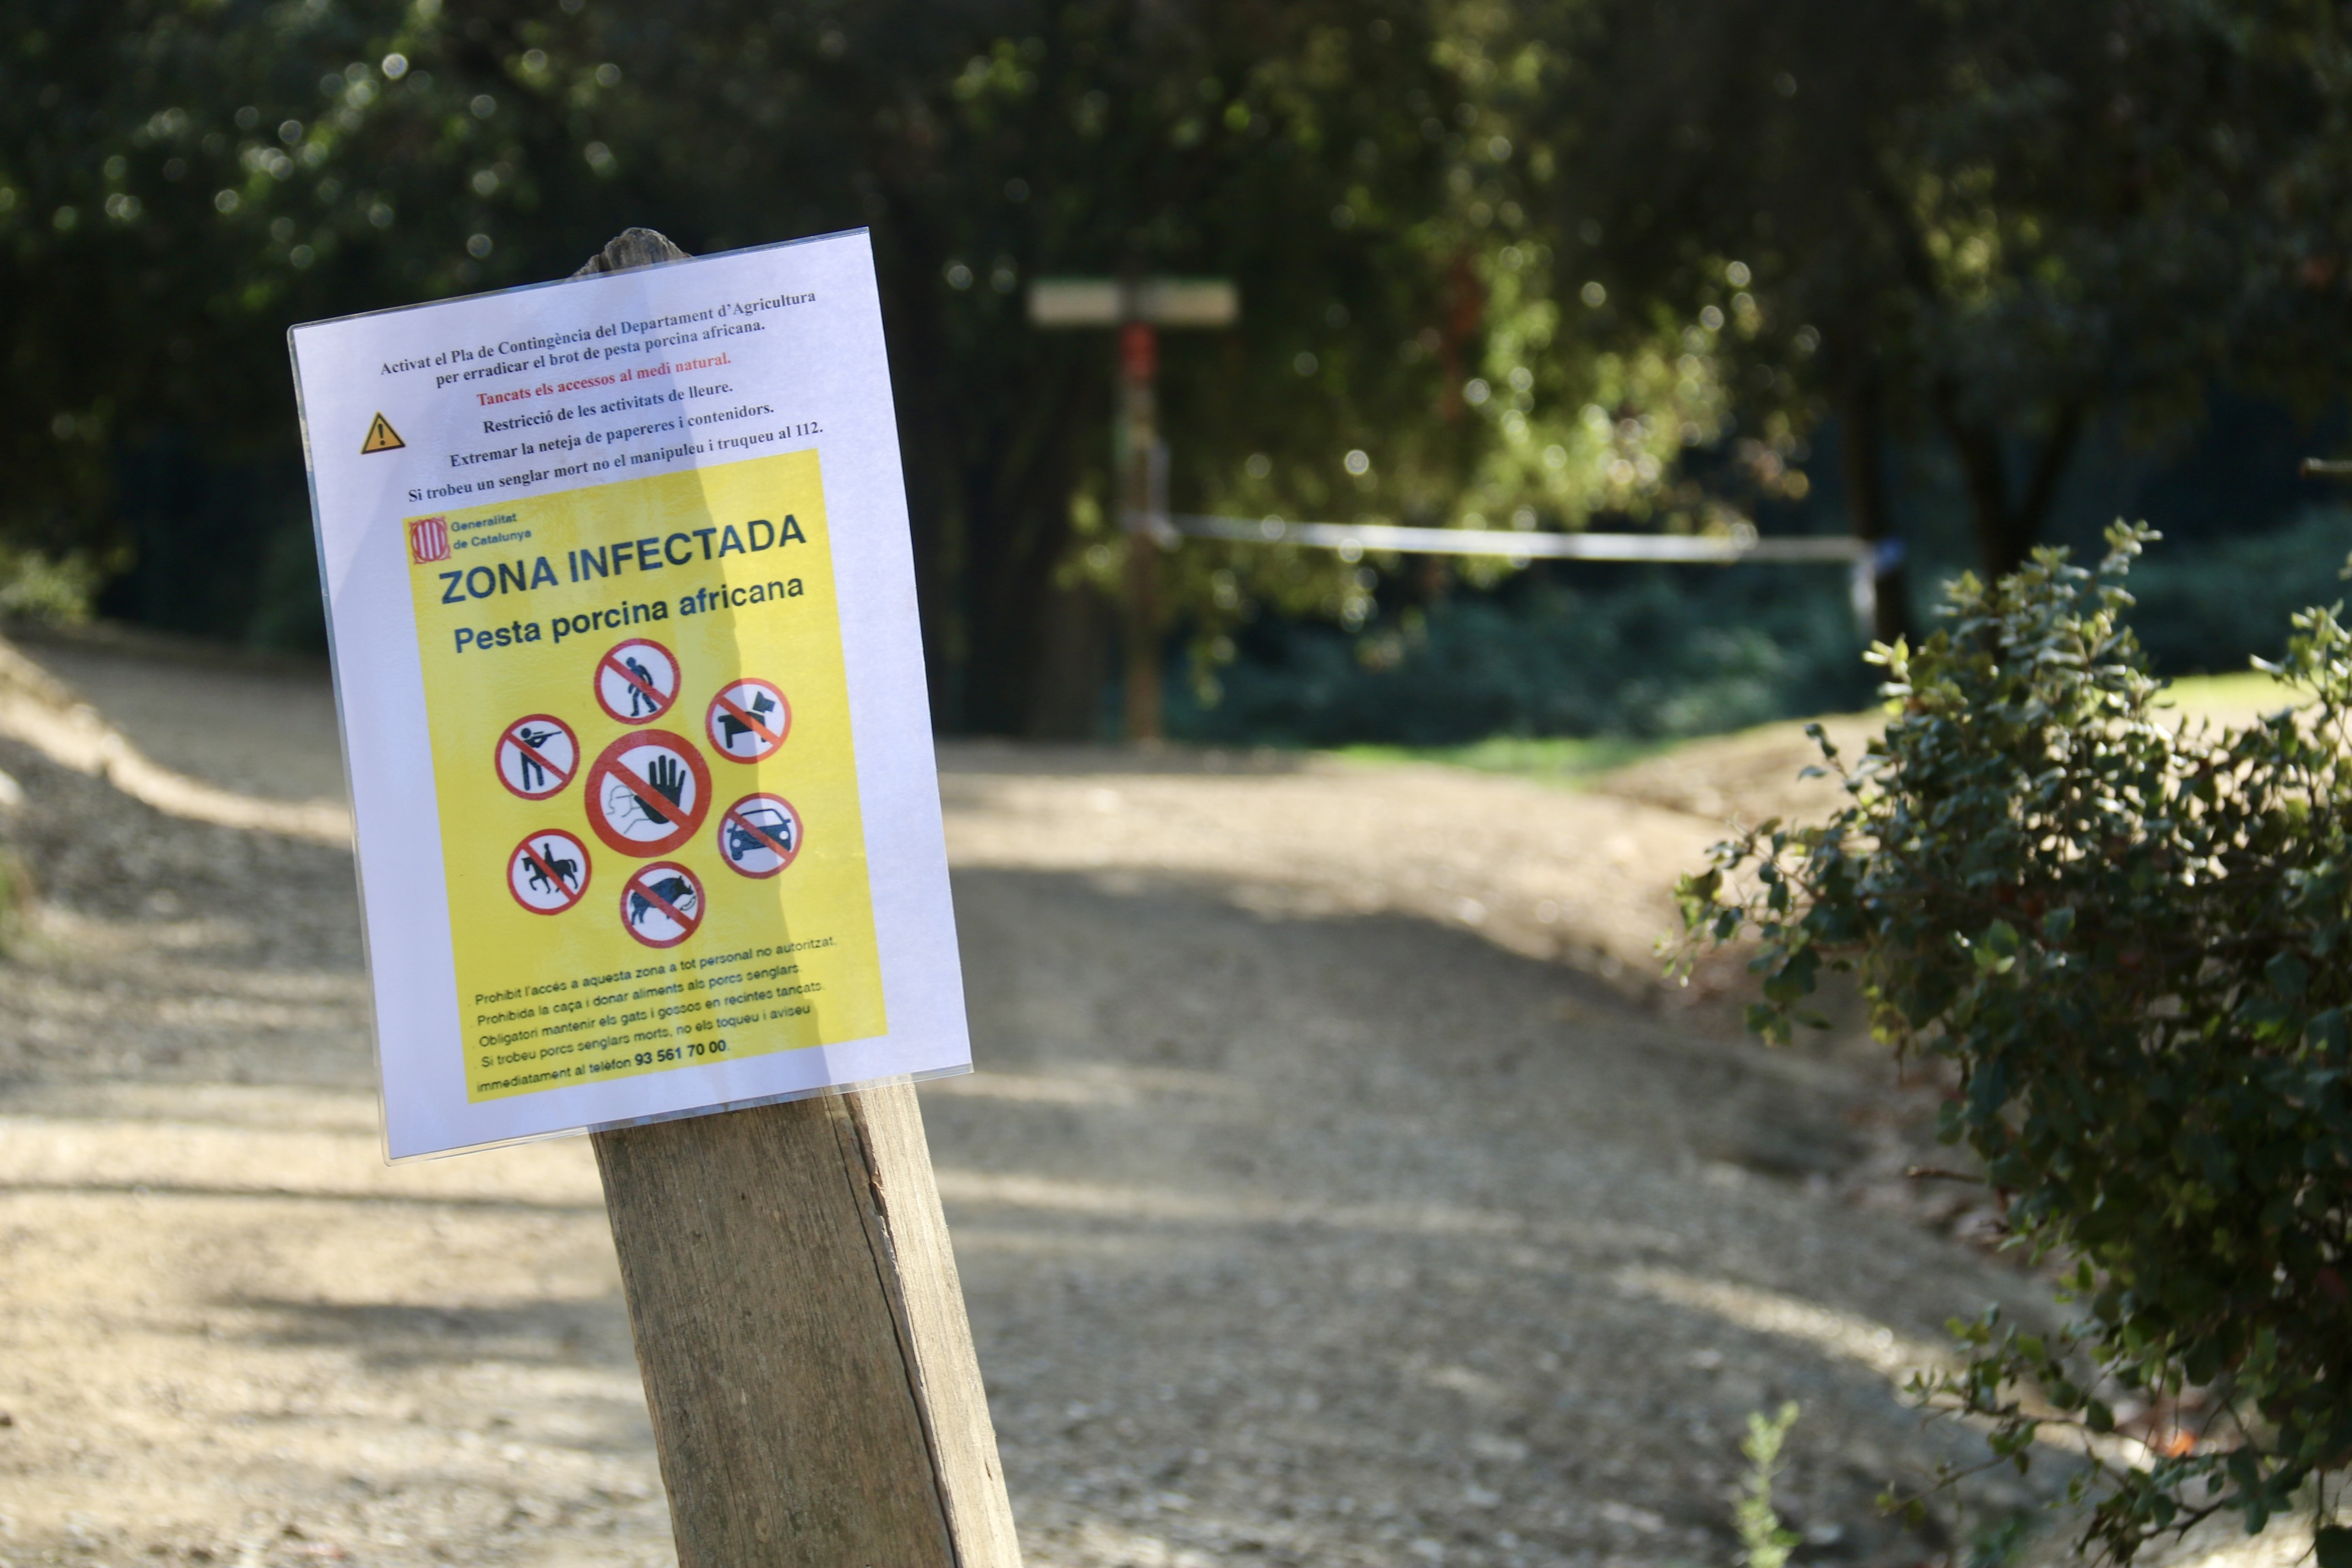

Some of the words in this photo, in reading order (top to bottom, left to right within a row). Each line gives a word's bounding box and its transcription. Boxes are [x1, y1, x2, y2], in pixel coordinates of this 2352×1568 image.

[380, 356, 431, 375] Activat
[434, 352, 447, 366] el
[450, 349, 474, 363] Pla
[477, 345, 494, 358] de
[497, 328, 592, 355] Contingència
[595, 323, 617, 339] del
[620, 308, 714, 334] Departament
[435, 372, 460, 389] per
[462, 360, 530, 380] erradicar
[532, 355, 546, 368] el
[548, 351, 580, 366] brot
[582, 346, 600, 360] de
[603, 341, 641, 361] pesta
[644, 331, 699, 353] porcina
[702, 321, 765, 340] africana.
[476, 388, 532, 406] Tancats
[534, 382, 554, 396] els
[557, 374, 616, 393] accessos
[619, 368, 633, 382] al
[636, 361, 671, 379] medi
[674, 351, 731, 372] natural.
[482, 409, 553, 433] Restricció
[557, 407, 574, 421] de
[577, 405, 597, 417] les
[600, 393, 665, 413] activitats
[668, 388, 685, 402] de
[688, 383, 733, 399] lleure.
[407, 488, 423, 502] Si
[426, 483, 472, 499] trobeu
[476, 480, 495, 491] un
[498, 469, 550, 487] senglar
[553, 461, 589, 478] mort
[592, 460, 609, 471] no
[613, 453, 626, 467] el
[630, 443, 705, 465] manipuleu
[708, 438, 714, 451] i
[717, 432, 774, 450] truqueu
[777, 425, 792, 439] al
[795, 421, 824, 437] 112.
[449, 447, 518, 467] Extremar
[520, 442, 535, 455] la
[538, 434, 581, 452] neteja
[585, 431, 602, 444] de
[605, 420, 675, 444] papereres
[678, 416, 684, 428] i
[687, 404, 775, 427] contenidors.
[450, 512, 518, 532] Generalitat
[453, 539, 468, 549] de
[470, 530, 531, 547] Catalunya
[438, 556, 559, 605] ZONA
[567, 513, 807, 582] INFECTADA
[454, 620, 542, 654] Pesta
[551, 600, 669, 644] porcina
[679, 577, 804, 616] africana
[474, 988, 522, 1005] Prohibit
[570, 979, 579, 989] a
[582, 970, 632, 988] aquesta
[634, 965, 666, 979] zona
[668, 963, 678, 973] a
[679, 958, 696, 971] tot
[699, 948, 753, 970] personal
[755, 947, 772, 957] no
[476, 1008, 535, 1026] Prohibida
[537, 1005, 550, 1015] la
[552, 1000, 583, 1014] caça
[585, 996, 590, 1008] i
[592, 992, 629, 1006] donar
[632, 983, 684, 1000] aliments
[687, 978, 705, 990] als
[707, 973, 743, 990] porcs
[478, 1029, 538, 1048] Obligatori
[541, 1019, 596, 1036] mantenir
[598, 1014, 617, 1027] els
[619, 1010, 647, 1026] gats
[650, 1006, 655, 1019] i
[657, 1001, 701, 1020] gossos
[705, 998, 721, 1009] en
[723, 989, 773, 1005] recintes
[481, 1055, 493, 1068] Si
[496, 1050, 536, 1065] trobeu
[539, 1043, 574, 1060] porcs
[577, 1035, 630, 1052] senglars
[676, 1024, 693, 1035] no
[695, 1019, 714, 1032] els
[715, 1013, 759, 1028] toqueu
[762, 1009, 766, 1020] i
[770, 1005, 810, 1019] aviseu
[477, 1066, 571, 1092] immediatament
[574, 1064, 585, 1076] al
[588, 1058, 631, 1073] telèfon
[634, 1051, 653, 1066] 93
[656, 1046, 682, 1063] 561
[686, 1042, 705, 1057] 70
